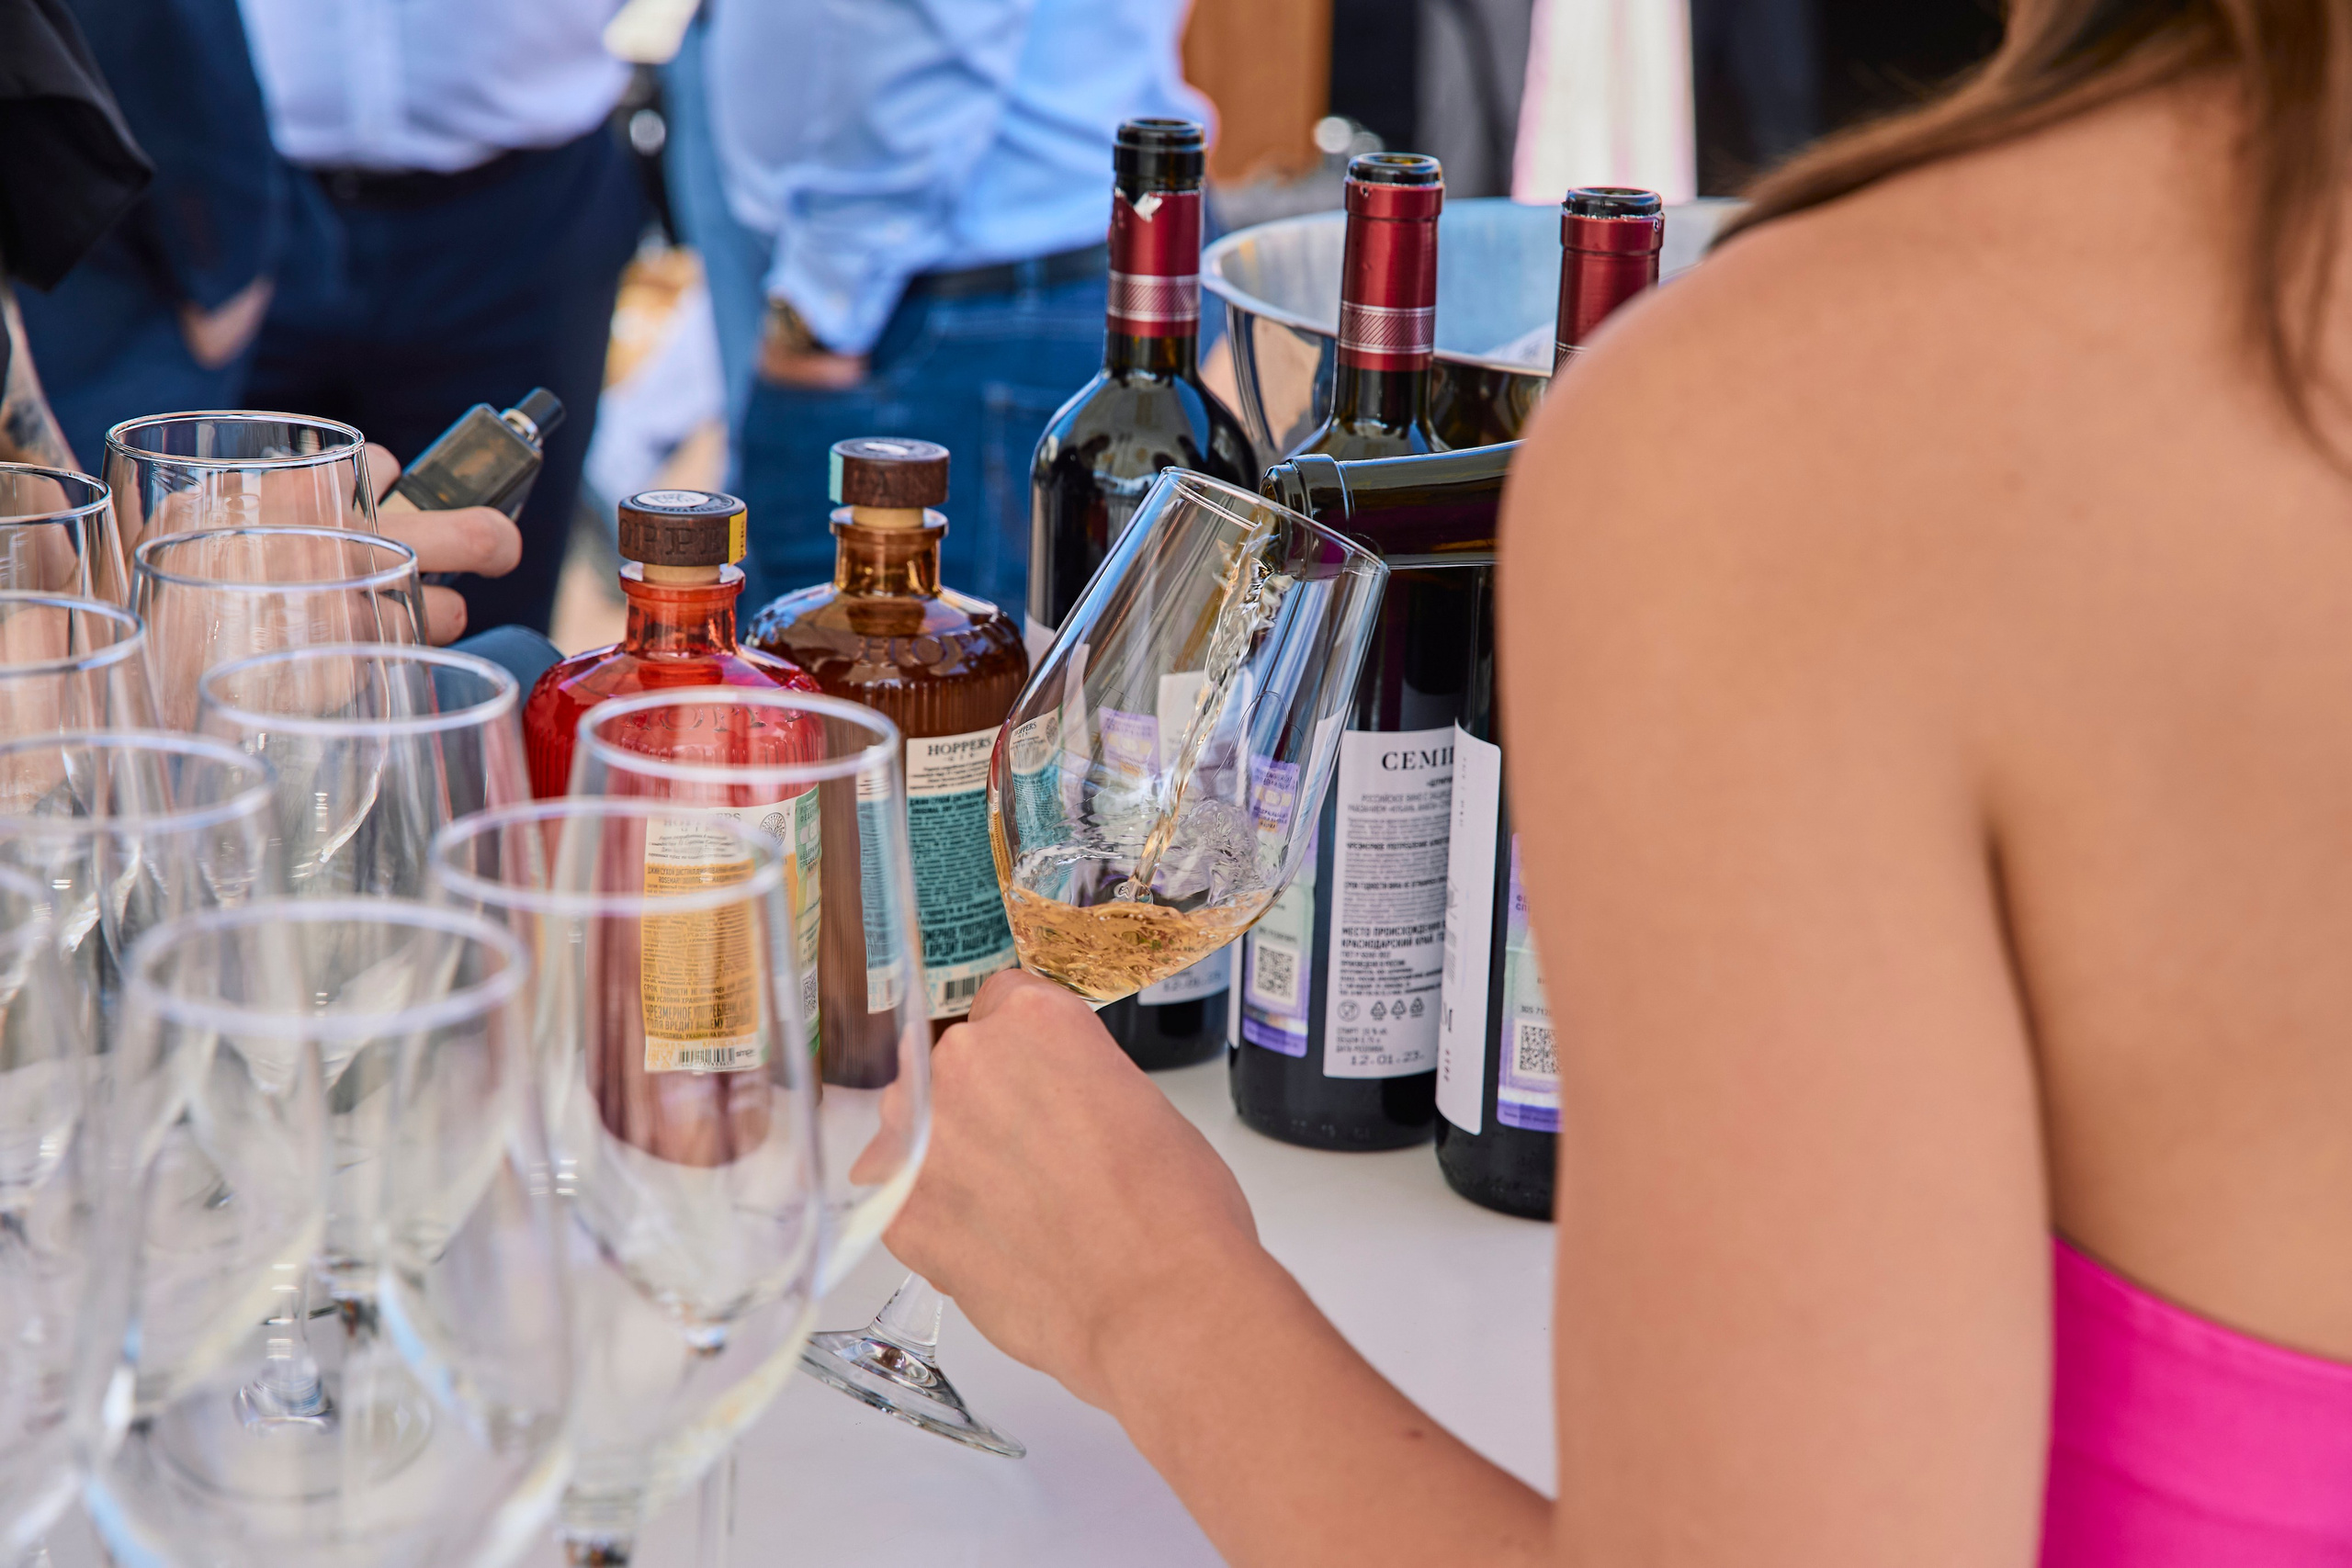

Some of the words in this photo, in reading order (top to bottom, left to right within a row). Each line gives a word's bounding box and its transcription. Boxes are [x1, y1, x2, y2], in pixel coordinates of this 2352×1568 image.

[927, 737, 991, 756] HOPPERS
[1341, 926, 1372, 936] МЕСТО
[1341, 937, 1413, 949] КРАСНОДАРСКИЙ
[643, 984, 658, 992] СРОК
[660, 986, 688, 995] ГОДНОСТИ
[645, 1004, 692, 1021] ЧРЕЗМЕРНОЕ
[665, 1018, 694, 1032] ВРЕДИТ
